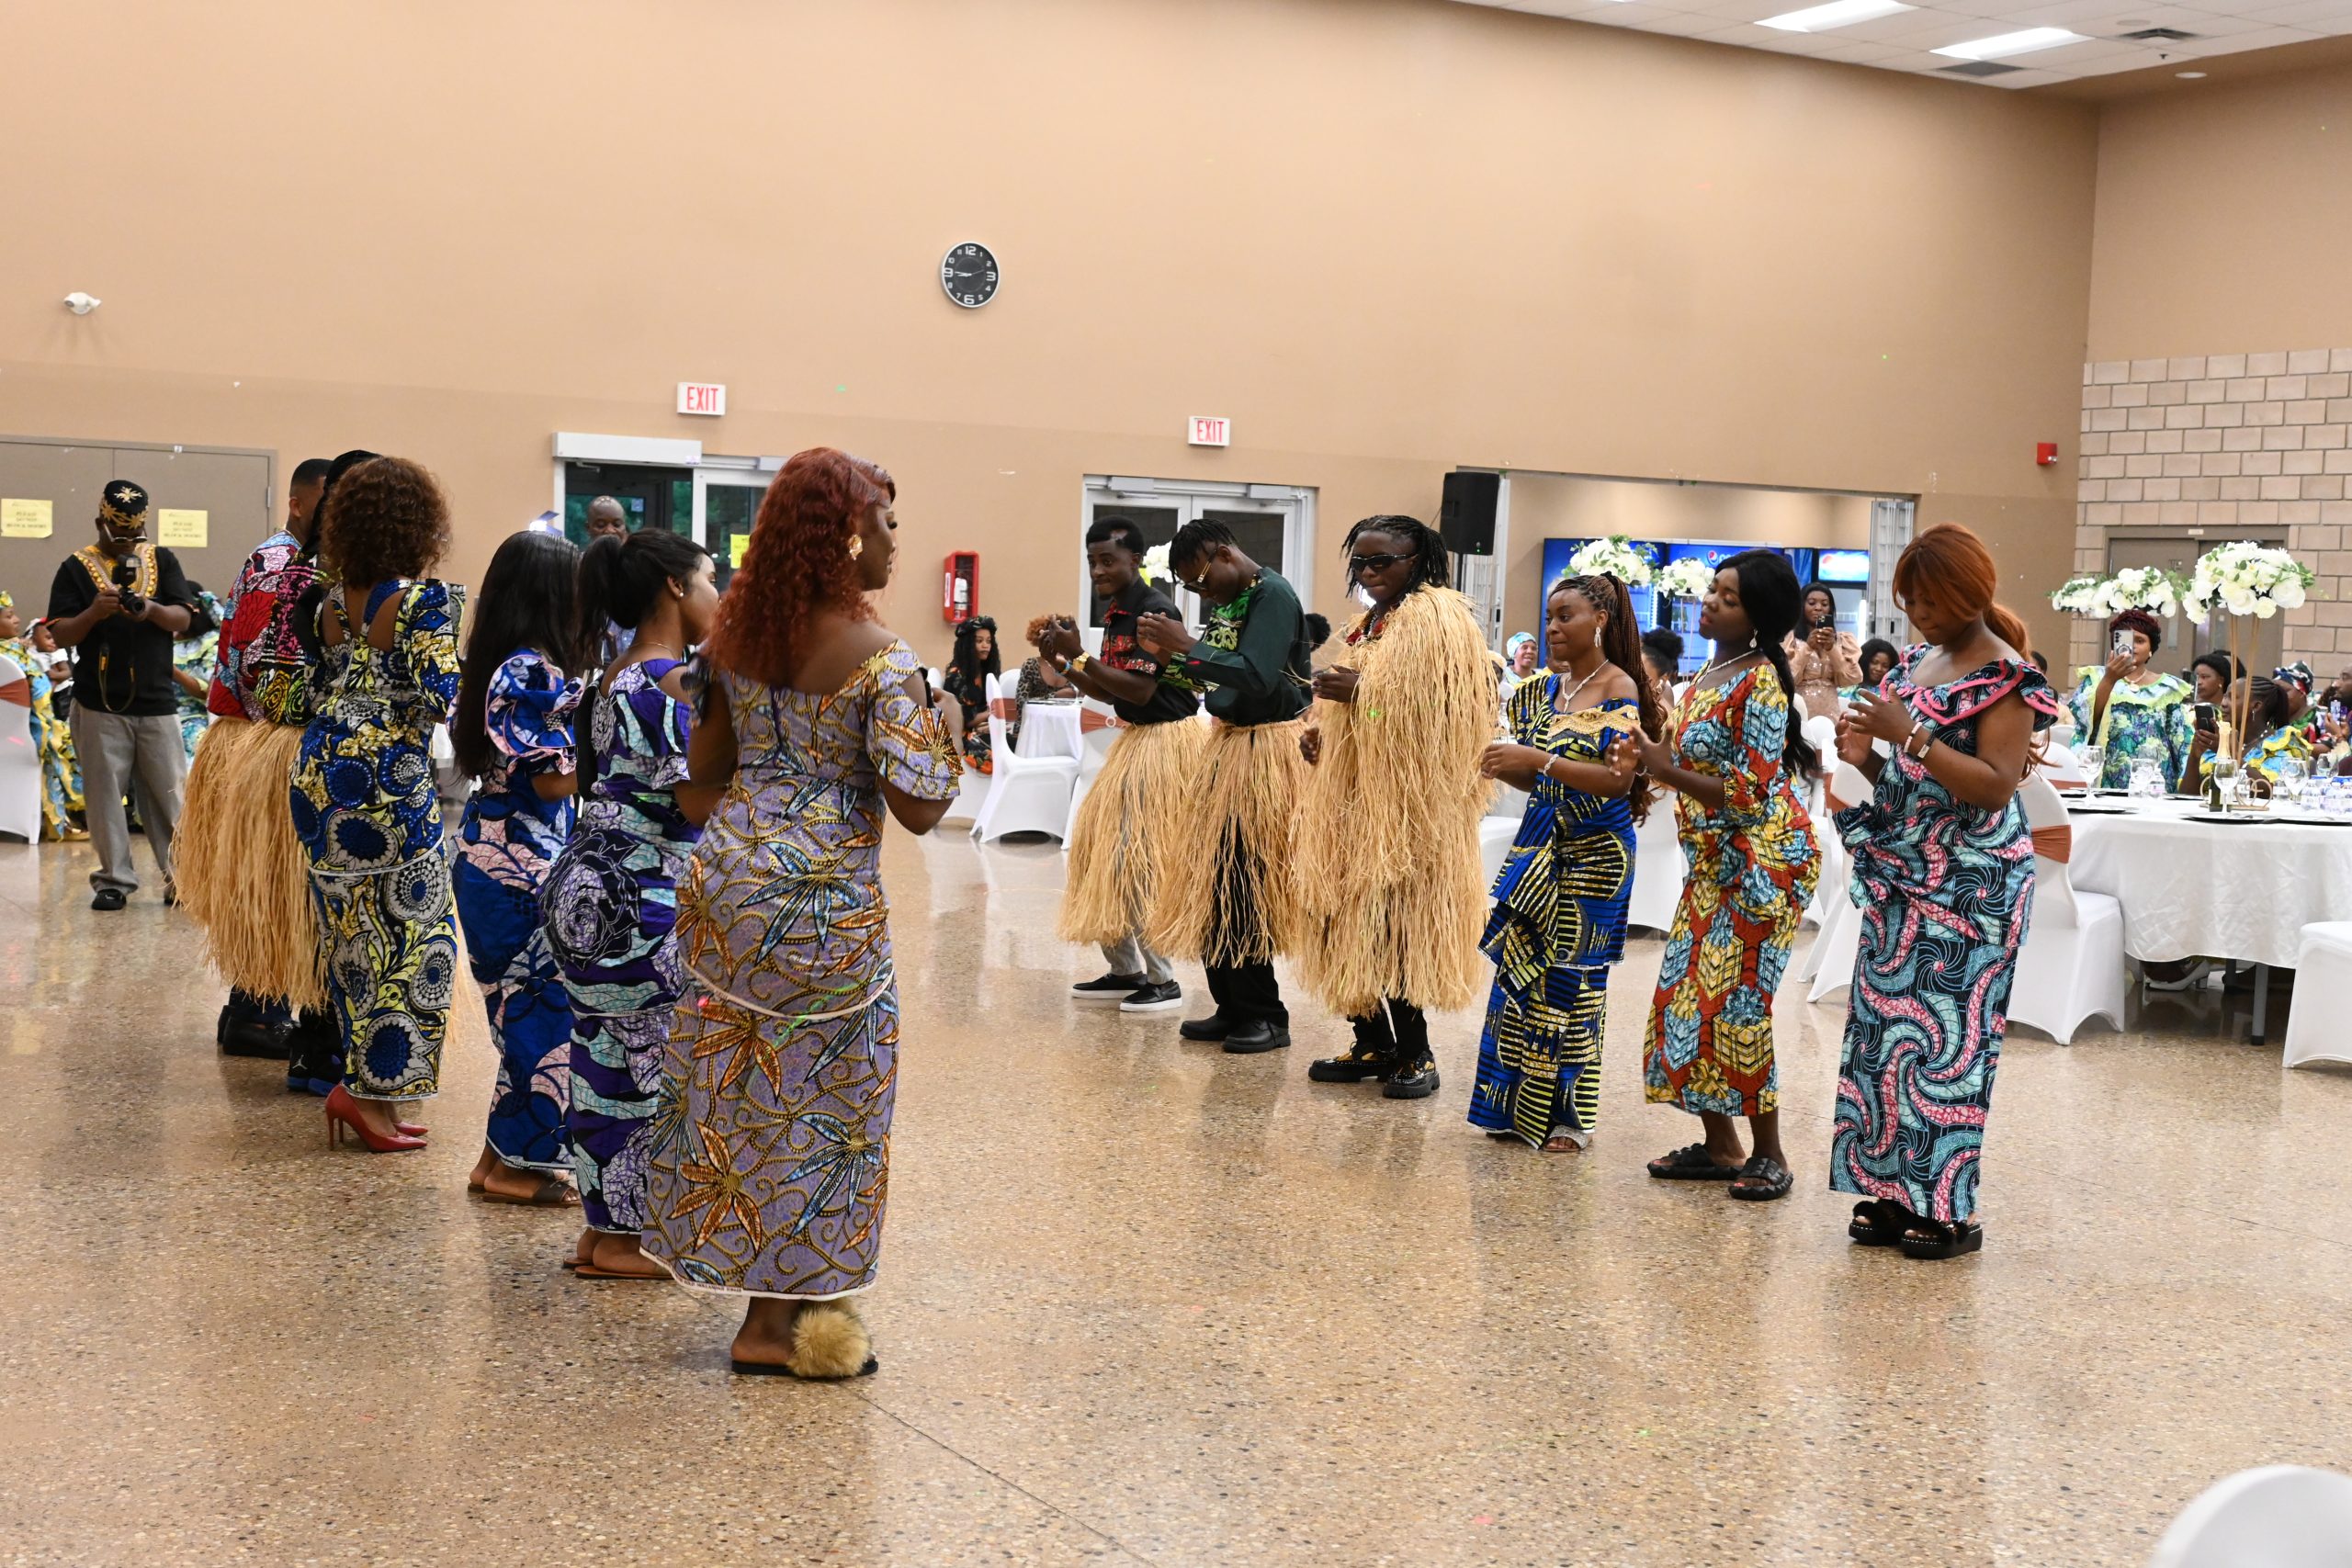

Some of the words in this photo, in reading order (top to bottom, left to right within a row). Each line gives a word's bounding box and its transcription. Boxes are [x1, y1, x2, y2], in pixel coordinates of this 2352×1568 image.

[965, 245, 977, 255] 12
[944, 267, 954, 277] 9
[986, 271, 997, 282] 3
[964, 294, 975, 305] 6
[686, 386, 718, 412] EXIT
[1197, 420, 1224, 442] EXIT
